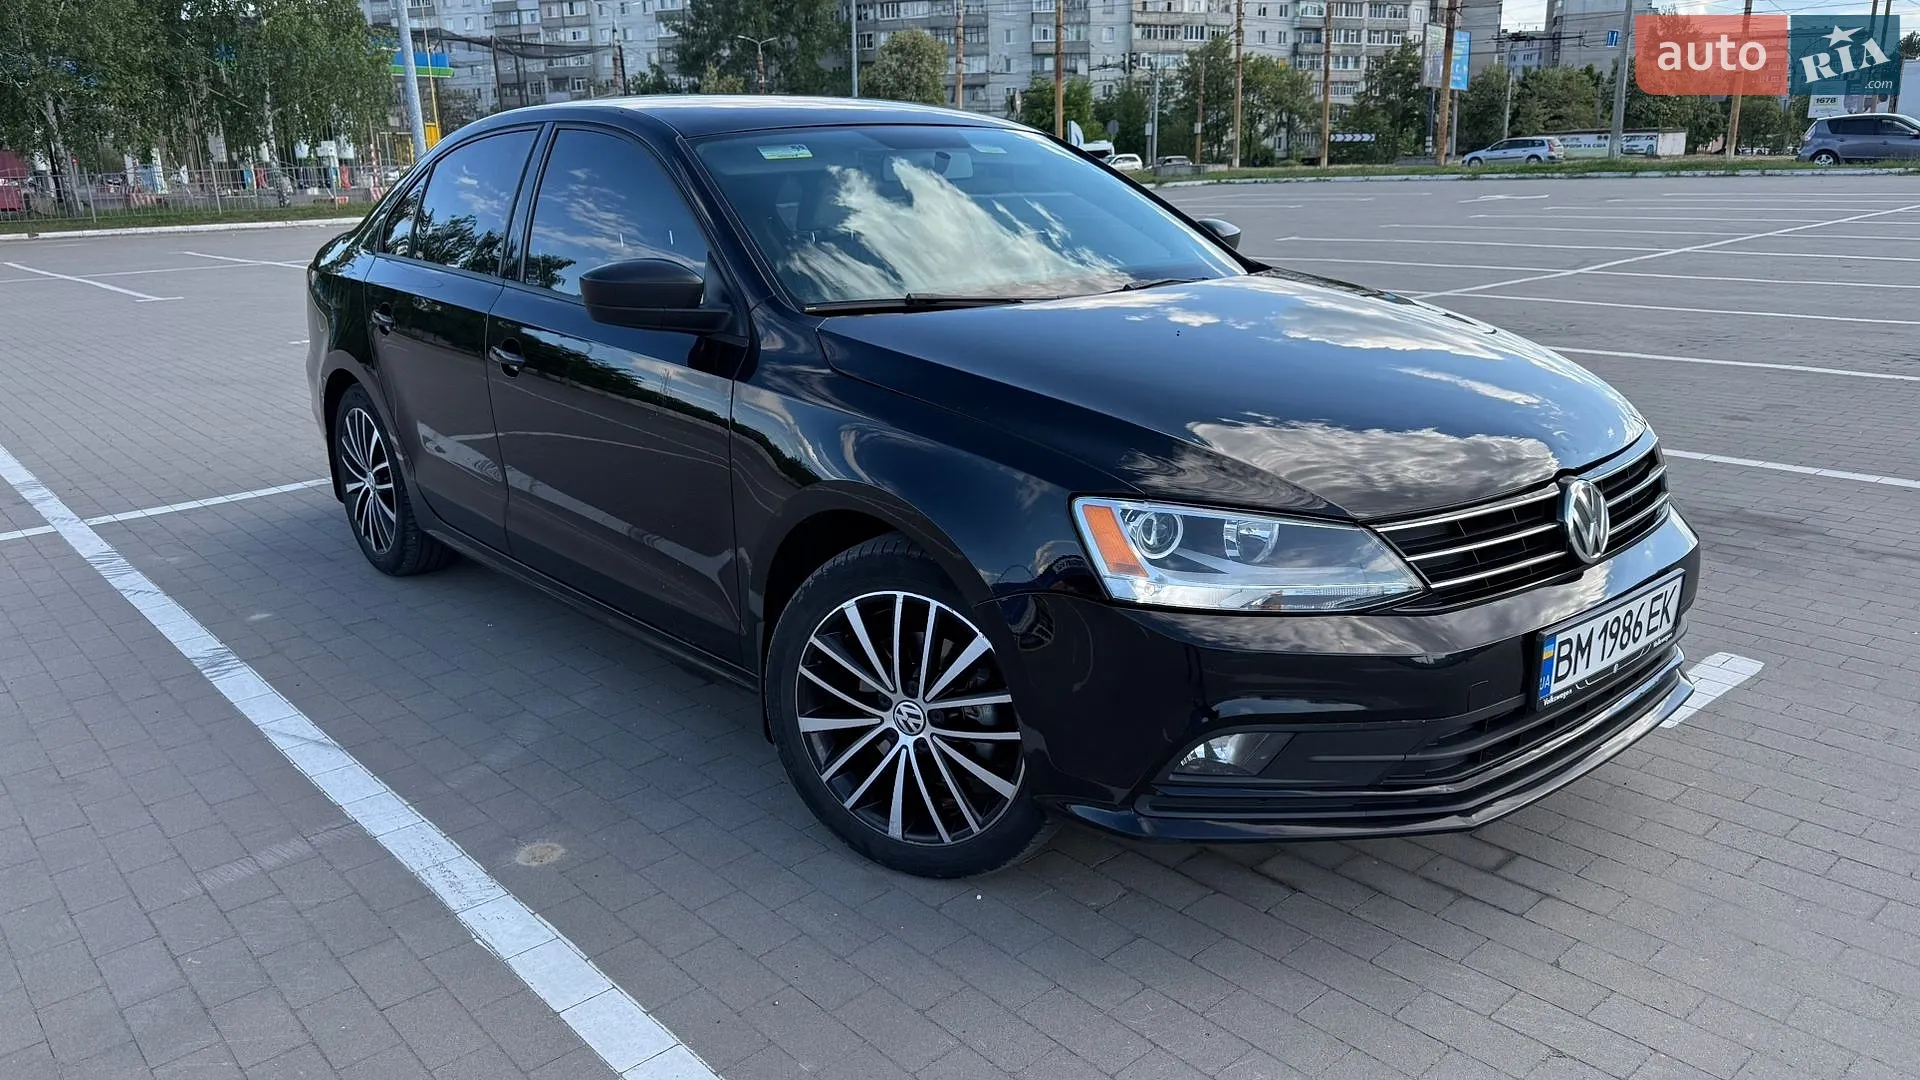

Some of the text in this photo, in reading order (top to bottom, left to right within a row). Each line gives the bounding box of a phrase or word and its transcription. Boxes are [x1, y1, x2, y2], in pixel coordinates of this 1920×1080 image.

[1553, 584, 1678, 685] BM 1986 EK
[1539, 674, 1550, 690] UA
